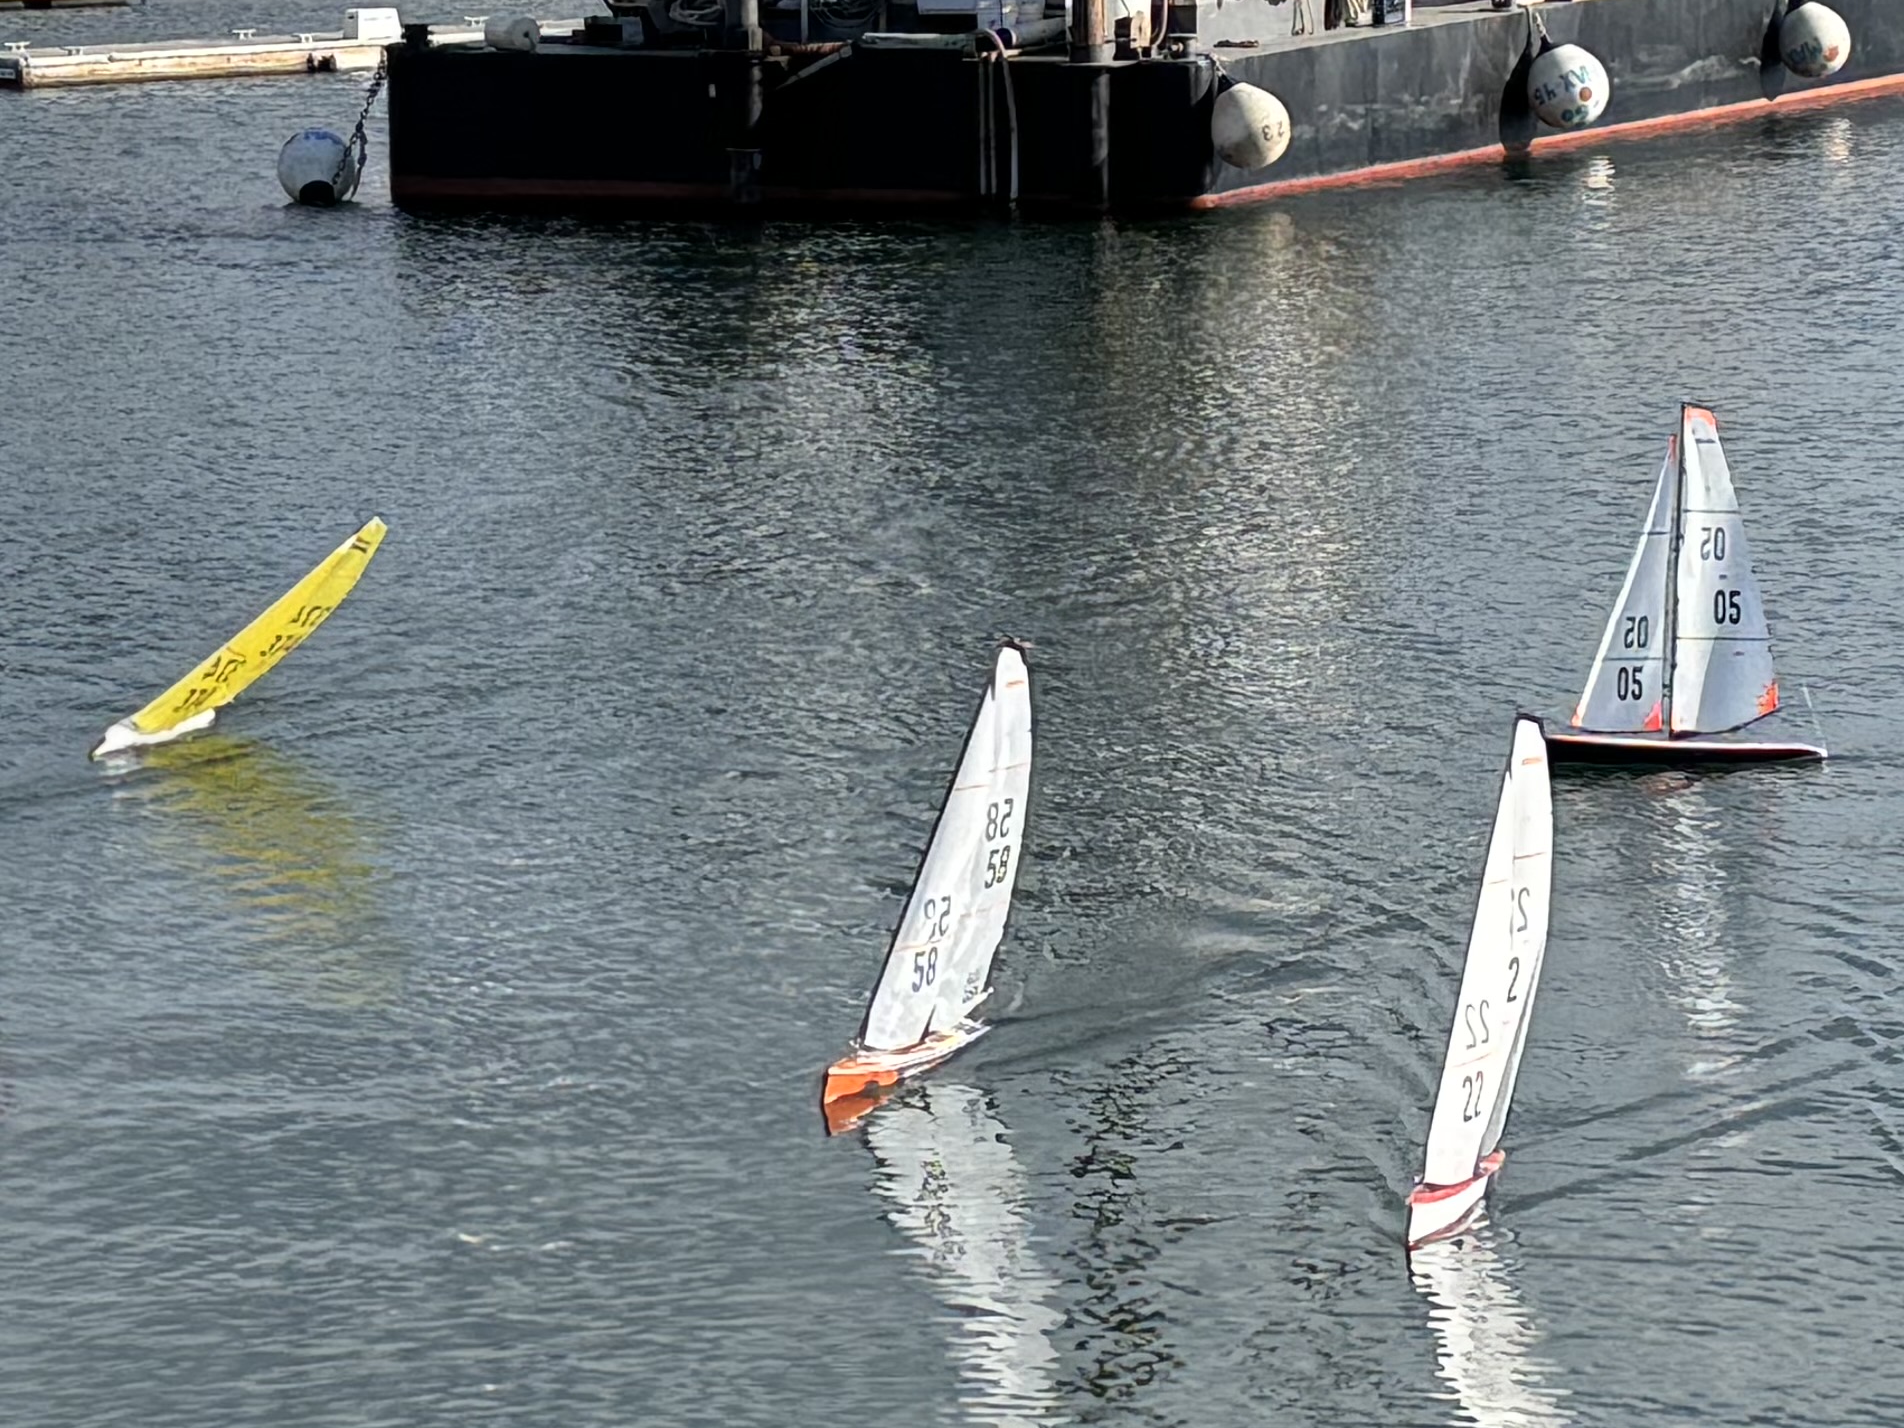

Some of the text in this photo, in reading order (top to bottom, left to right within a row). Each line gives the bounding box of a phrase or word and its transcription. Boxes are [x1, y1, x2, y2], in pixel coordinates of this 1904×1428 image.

[1713, 589, 1741, 625] 05
[1617, 666, 1644, 701] 05
[984, 845, 1011, 889] 58
[911, 947, 939, 993] 58
[1462, 1070, 1484, 1123] 22
